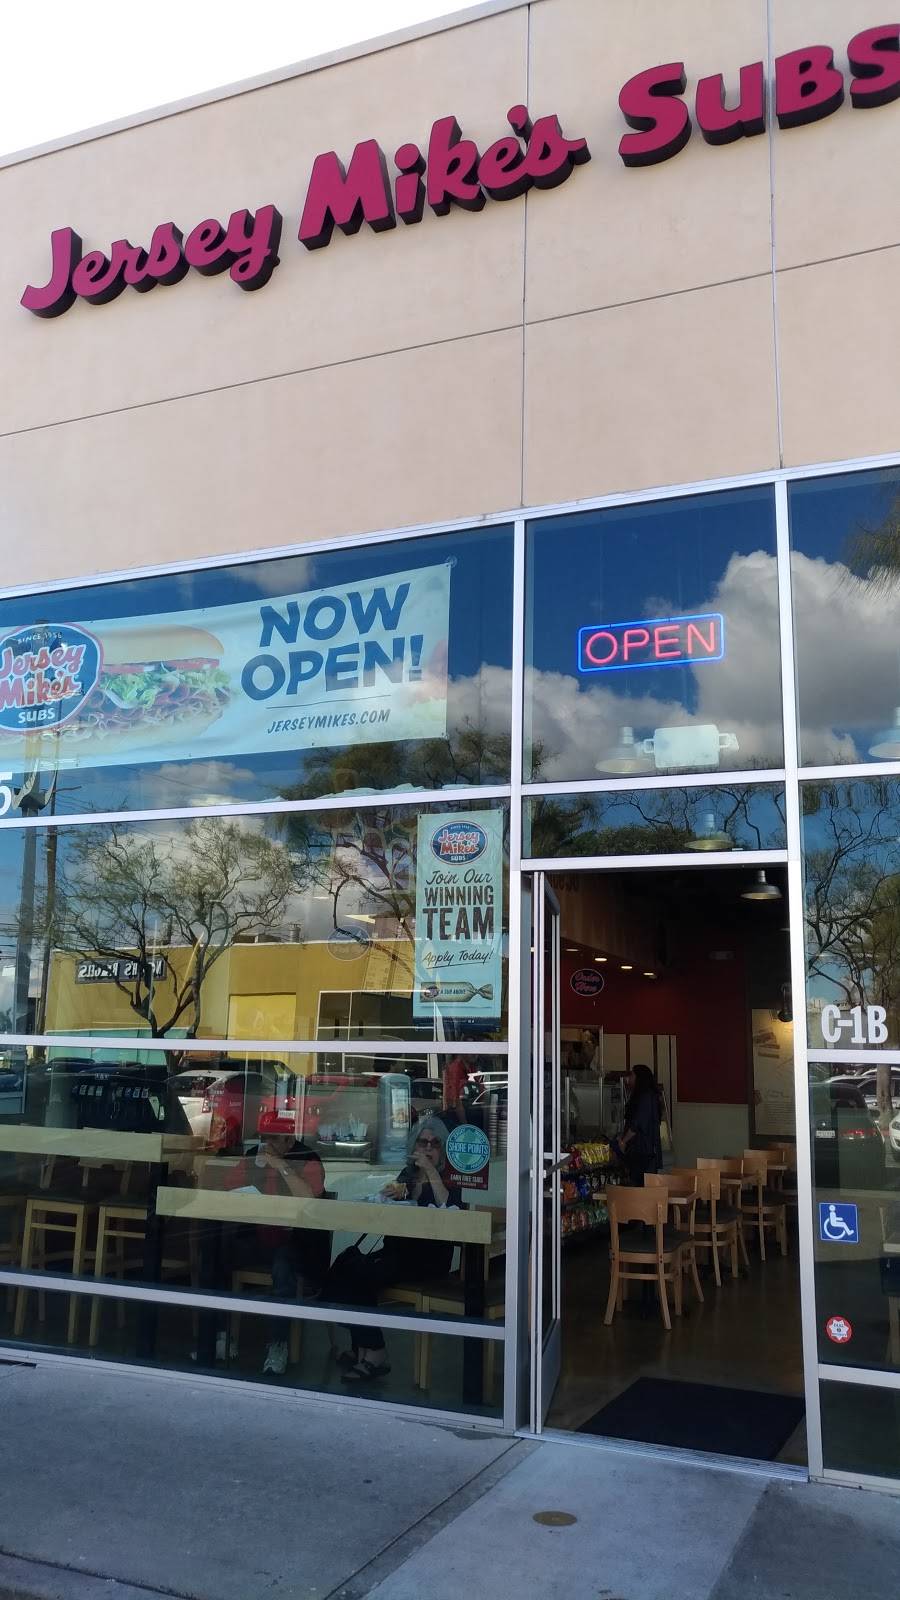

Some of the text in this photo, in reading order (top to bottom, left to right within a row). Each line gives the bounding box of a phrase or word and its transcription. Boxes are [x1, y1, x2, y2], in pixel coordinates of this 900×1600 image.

[21, 204, 282, 318] Jersey
[298, 105, 591, 250] Mike's
[259, 583, 411, 648] NOW
[585, 621, 717, 665] OPEN
[0, 645, 86, 677] Jersey
[241, 634, 424, 701] OPEN!
[18, 708, 56, 723] SUBS
[267, 708, 391, 734] JERSEYMIKES.COM
[438, 829, 480, 845] Jersey
[426, 868, 492, 885] Join Our
[424, 885, 494, 906] WINNING
[422, 906, 494, 940] TEAM
[423, 947, 494, 966] Apply Today!
[821, 1004, 889, 1044] C-1B
